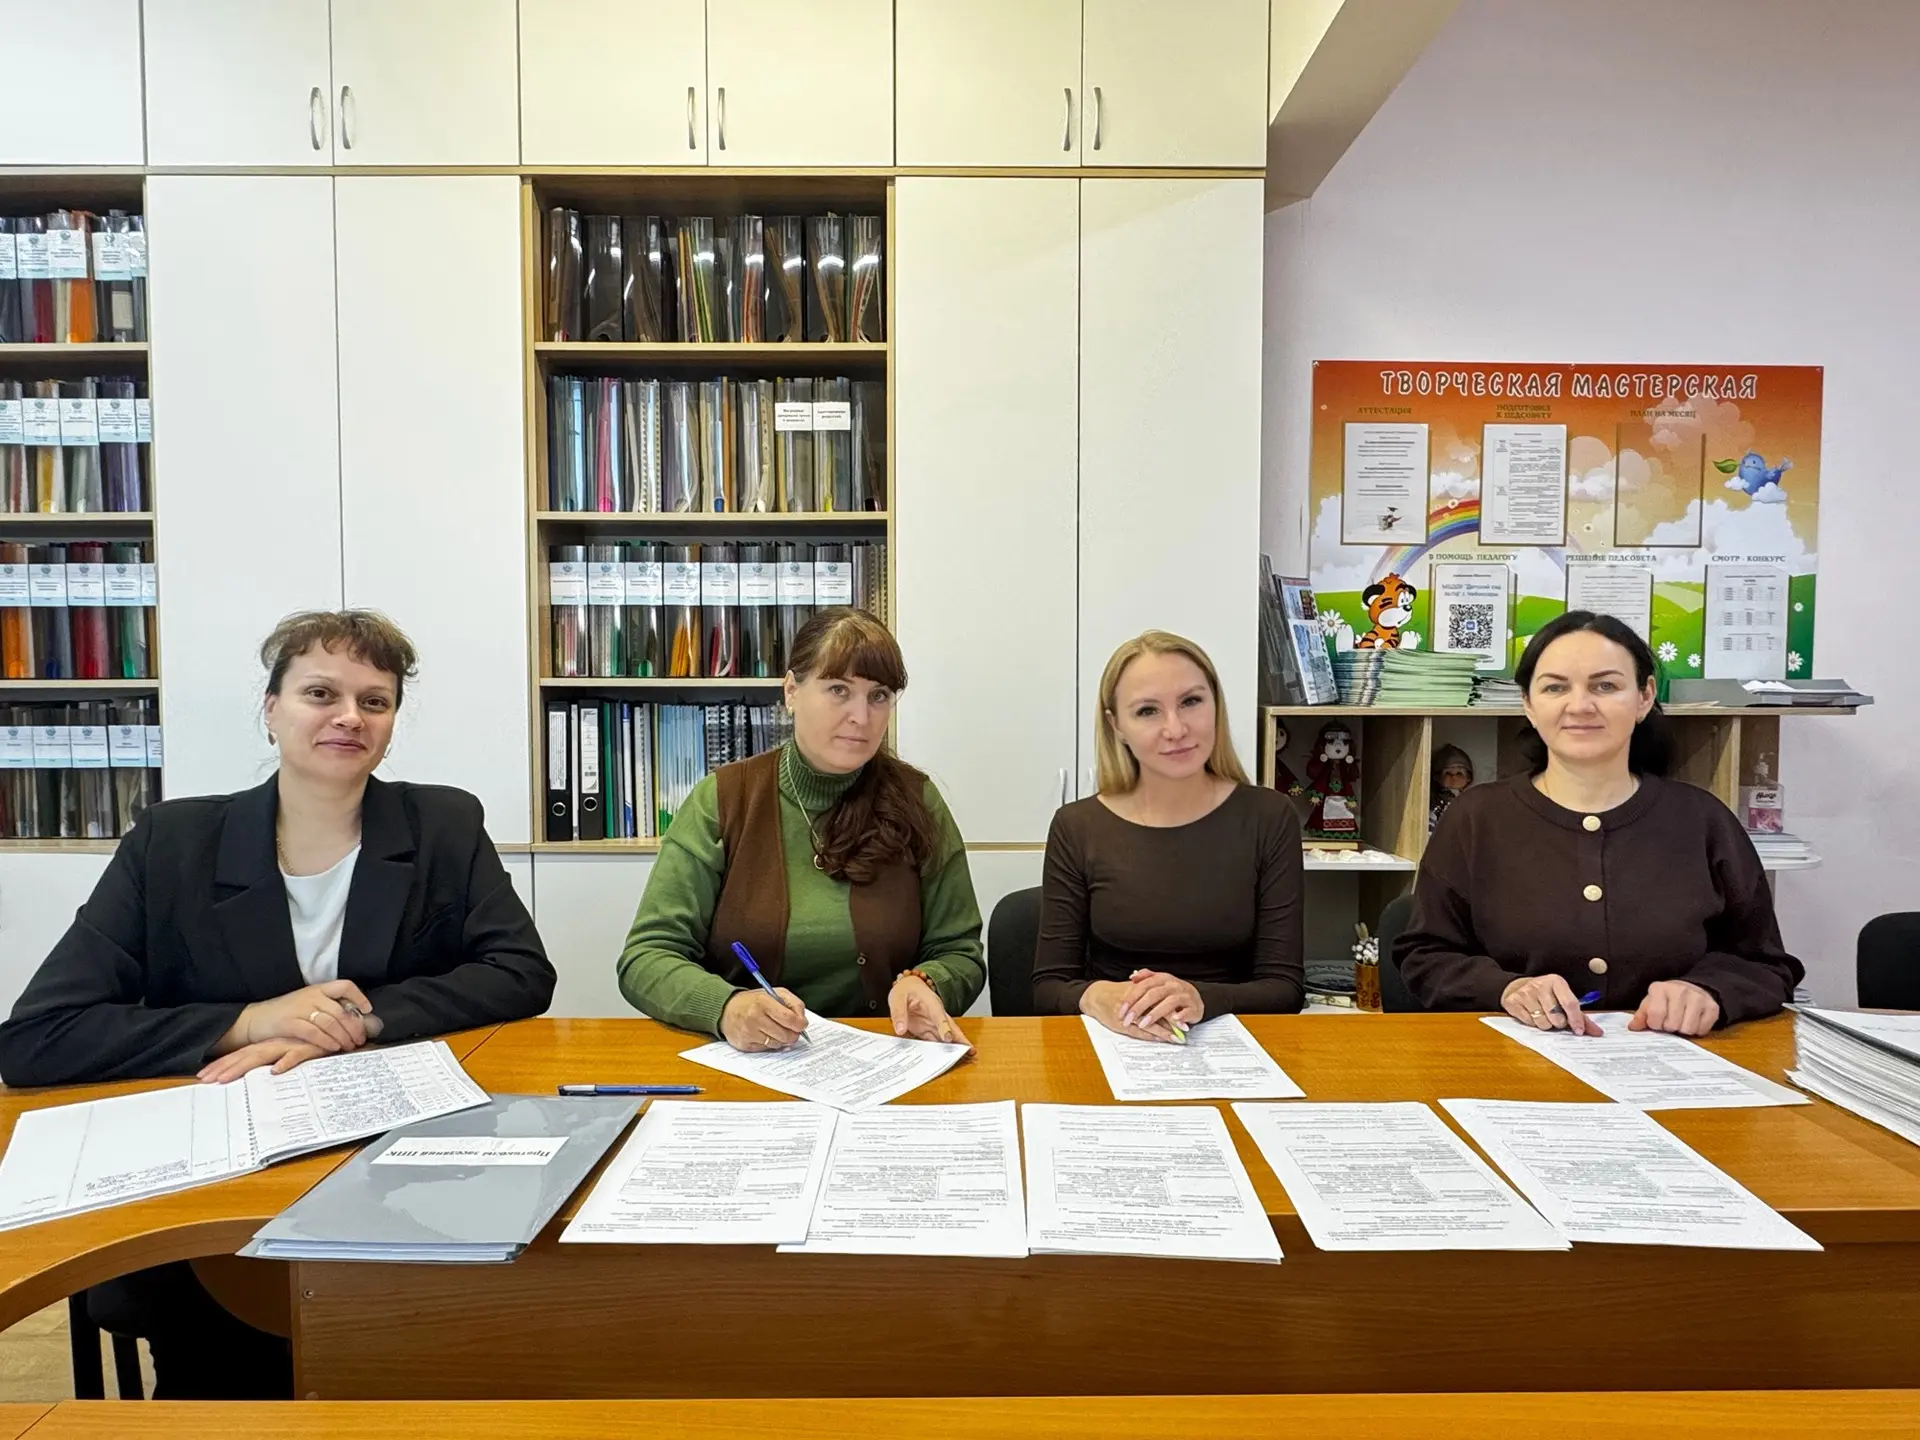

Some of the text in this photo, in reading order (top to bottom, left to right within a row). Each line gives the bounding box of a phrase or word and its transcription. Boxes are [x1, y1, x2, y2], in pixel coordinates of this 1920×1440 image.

[1381, 371, 1757, 399] ТВОРЧЕСКАЯ МАСТЕРСКАЯ
[1357, 406, 1412, 415] АТТЕСТАЦИЯ
[1668, 410, 1696, 418] МЕСЯЦ
[1436, 553, 1473, 561] ПОМОЩЬ
[482, 1150, 551, 1158] Протоколы
